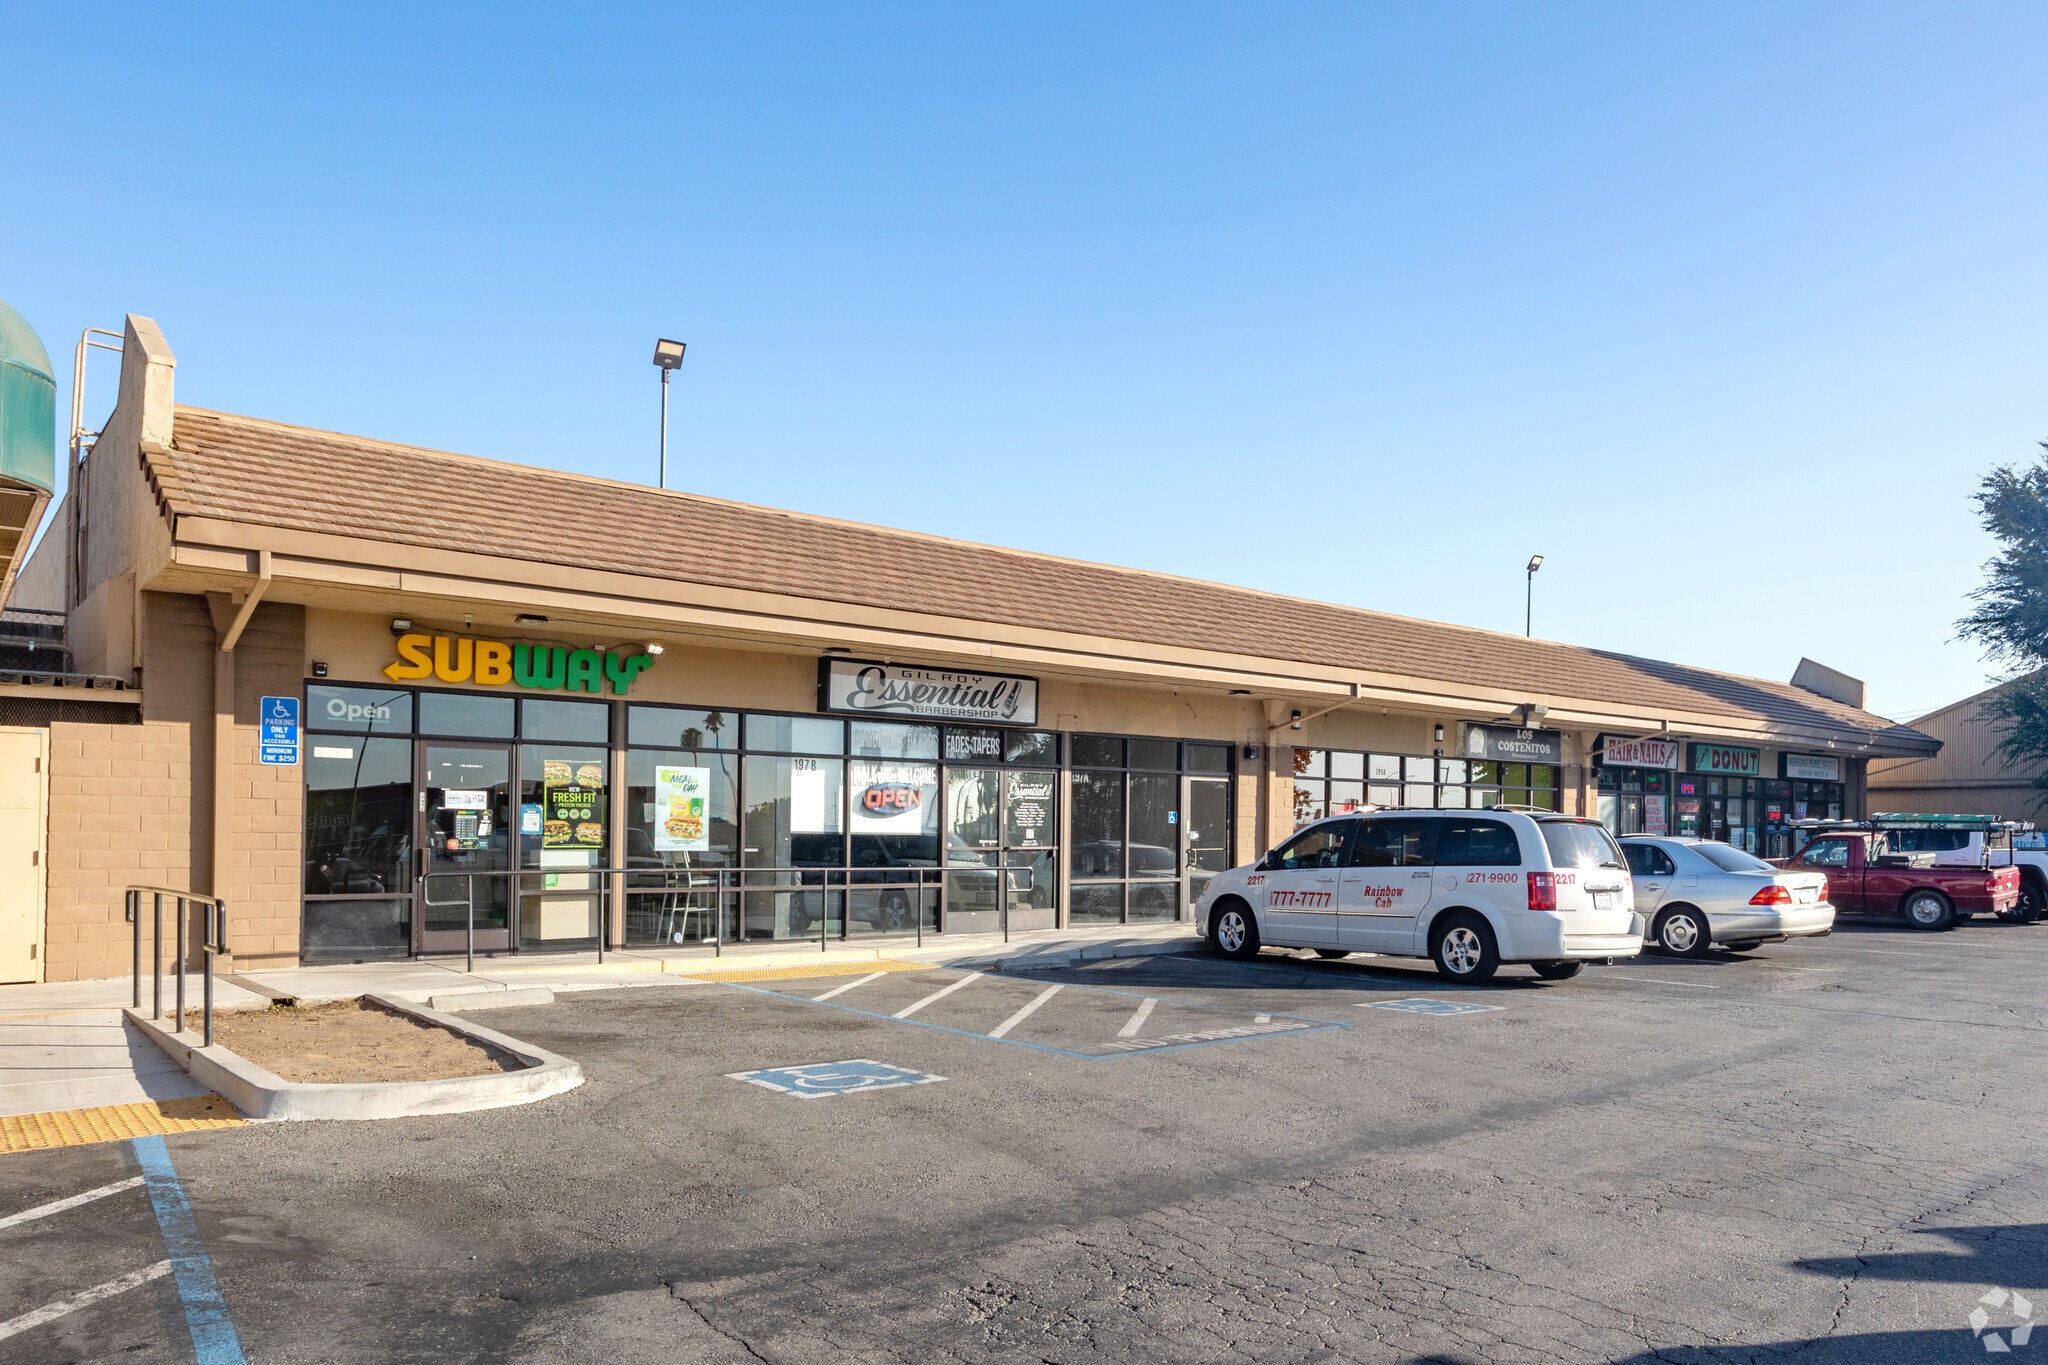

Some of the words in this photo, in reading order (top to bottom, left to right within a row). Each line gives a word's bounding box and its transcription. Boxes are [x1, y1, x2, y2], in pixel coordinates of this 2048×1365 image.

[383, 633, 655, 695] SUBWAY
[902, 670, 983, 684] GILROY
[847, 666, 1007, 713] Essential
[327, 698, 390, 721] Open
[916, 706, 998, 719] BARBERSHOP
[265, 718, 295, 727] PARKING
[270, 726, 289, 734] ONLY
[1516, 729, 1533, 740] LOS
[266, 747, 293, 755] MINIMUM
[945, 735, 970, 753] FADES
[972, 736, 1001, 755] TAPERS
[1497, 740, 1551, 754] COSTEÑITOS
[1511, 752, 1538, 760] Restaurant
[1608, 739, 1633, 762] HAIR
[1639, 742, 1666, 765] NAILS
[1711, 749, 1758, 772] DONUT
[670, 775, 692, 784] MEAL
[682, 783, 699, 793] DAY
[1007, 782, 1048, 800] Essential
[553, 792, 581, 803] FRESH
[583, 793, 596, 803] FIT
[865, 788, 923, 809] OPEN
[1247, 875, 1265, 886] 2217
[1555, 873, 1576, 885] 2217
[1363, 885, 1404, 897] Rainbow
[1273, 890, 1332, 907] 777-7777
[1374, 897, 1393, 908] Cab
